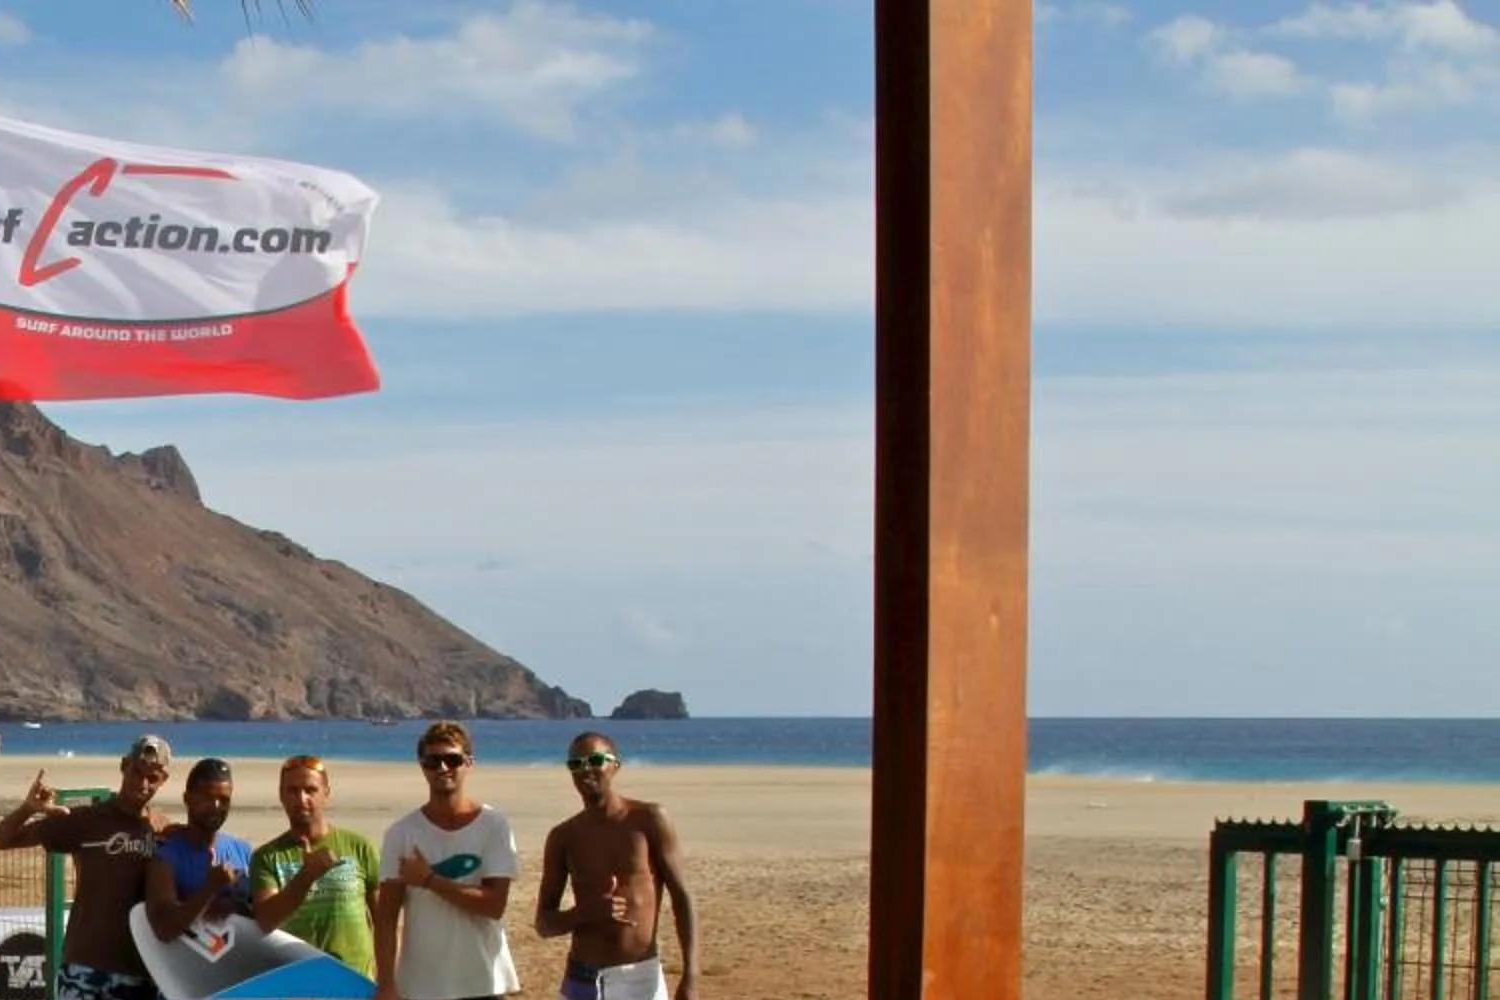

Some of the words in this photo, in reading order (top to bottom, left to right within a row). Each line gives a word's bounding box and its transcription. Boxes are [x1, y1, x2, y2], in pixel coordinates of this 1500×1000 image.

[67, 214, 331, 254] action.com
[15, 316, 59, 334] SURF
[60, 324, 131, 342] AROUND
[135, 328, 168, 342] THE
[170, 323, 233, 341] WORLD
